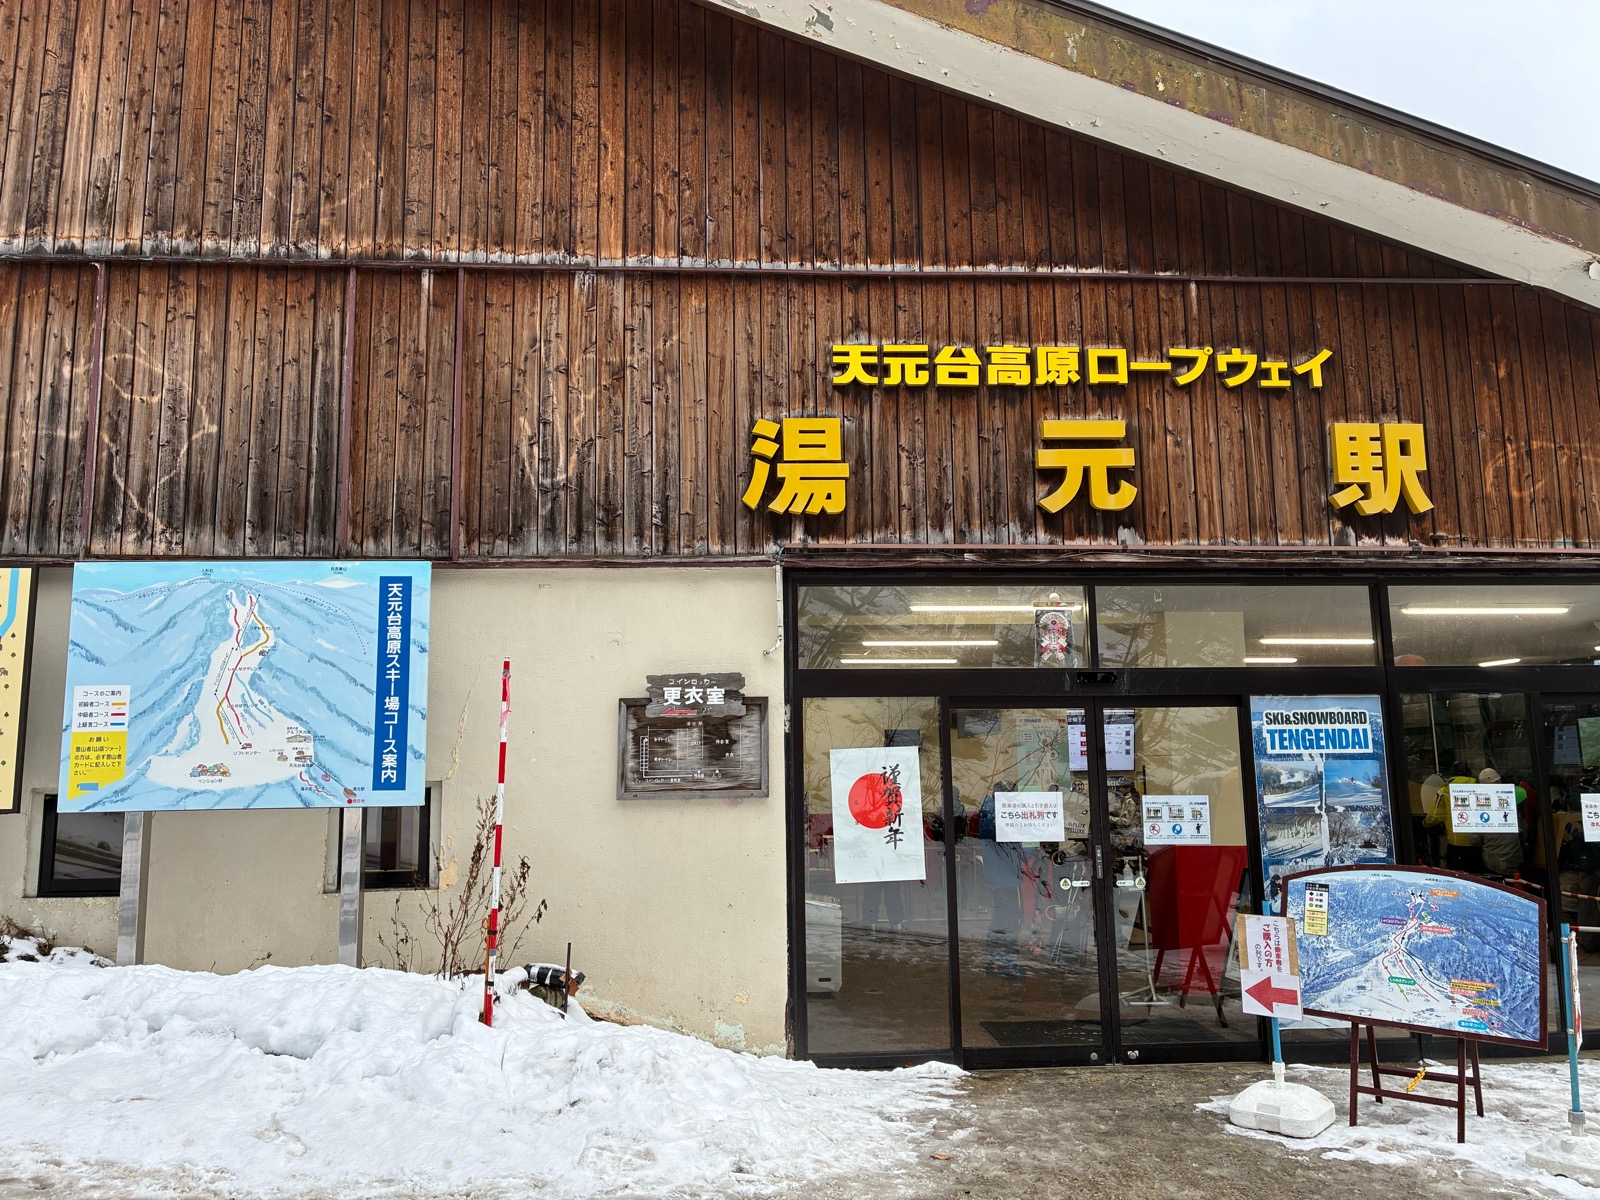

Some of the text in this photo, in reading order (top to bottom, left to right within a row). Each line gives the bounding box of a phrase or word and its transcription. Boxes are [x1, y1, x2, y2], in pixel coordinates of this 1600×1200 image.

[832, 345, 1333, 388] 天元台高原ロープウェイ
[381, 583, 403, 783] 天元台高原スキー場コース案内
[663, 686, 725, 705] 更衣室
[1264, 712, 1368, 725] SKI&SNOWBOARD
[1266, 728, 1370, 750] TENGENDAI
[880, 764, 904, 850] 謹賀新年
[1001, 811, 1058, 820] こちら出札列です
[1255, 944, 1263, 972] の列です。
[1262, 923, 1273, 968] ご購入の方
[1273, 920, 1282, 972] こちらは乗車券を
